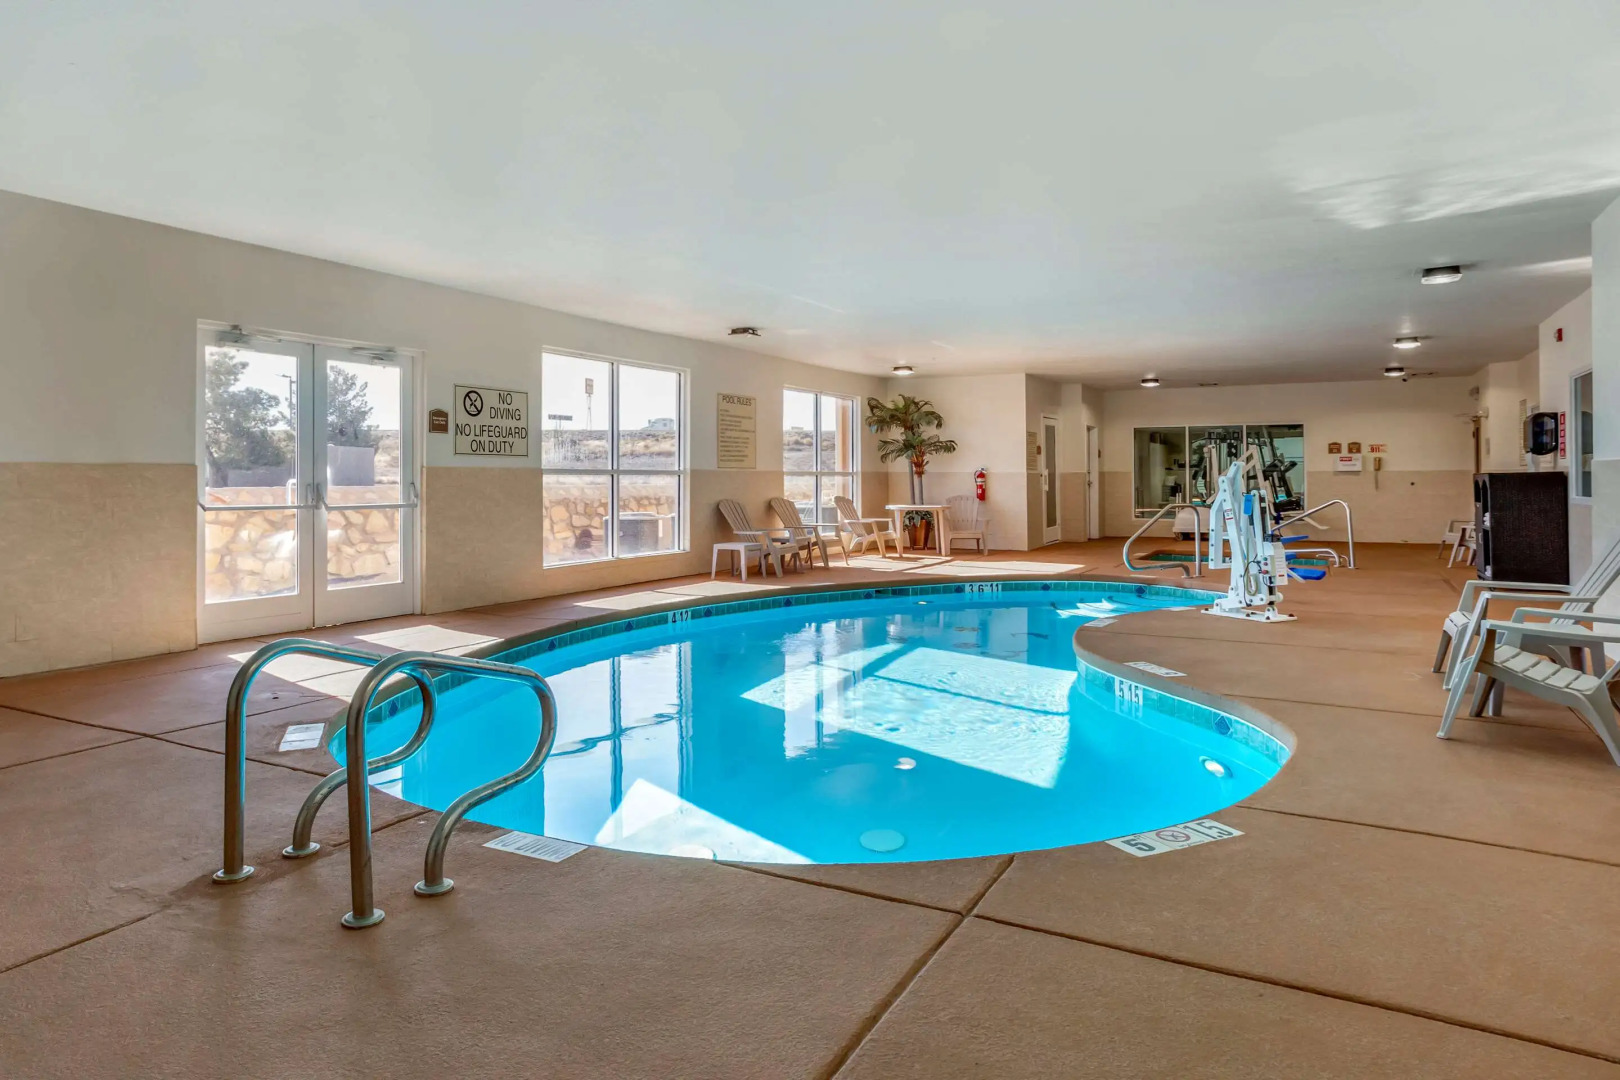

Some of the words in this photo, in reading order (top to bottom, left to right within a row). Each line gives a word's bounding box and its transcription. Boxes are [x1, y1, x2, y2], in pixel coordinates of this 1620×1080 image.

[498, 392, 513, 406] NO
[722, 395, 736, 404] POOL
[489, 406, 522, 421] DIVING
[456, 423, 471, 437] NO
[473, 424, 528, 439] LIFEGUARD
[470, 439, 486, 453] ON
[488, 440, 515, 454] DUTY
[1121, 838, 1156, 852] 5
[1182, 821, 1234, 840] 1.5
